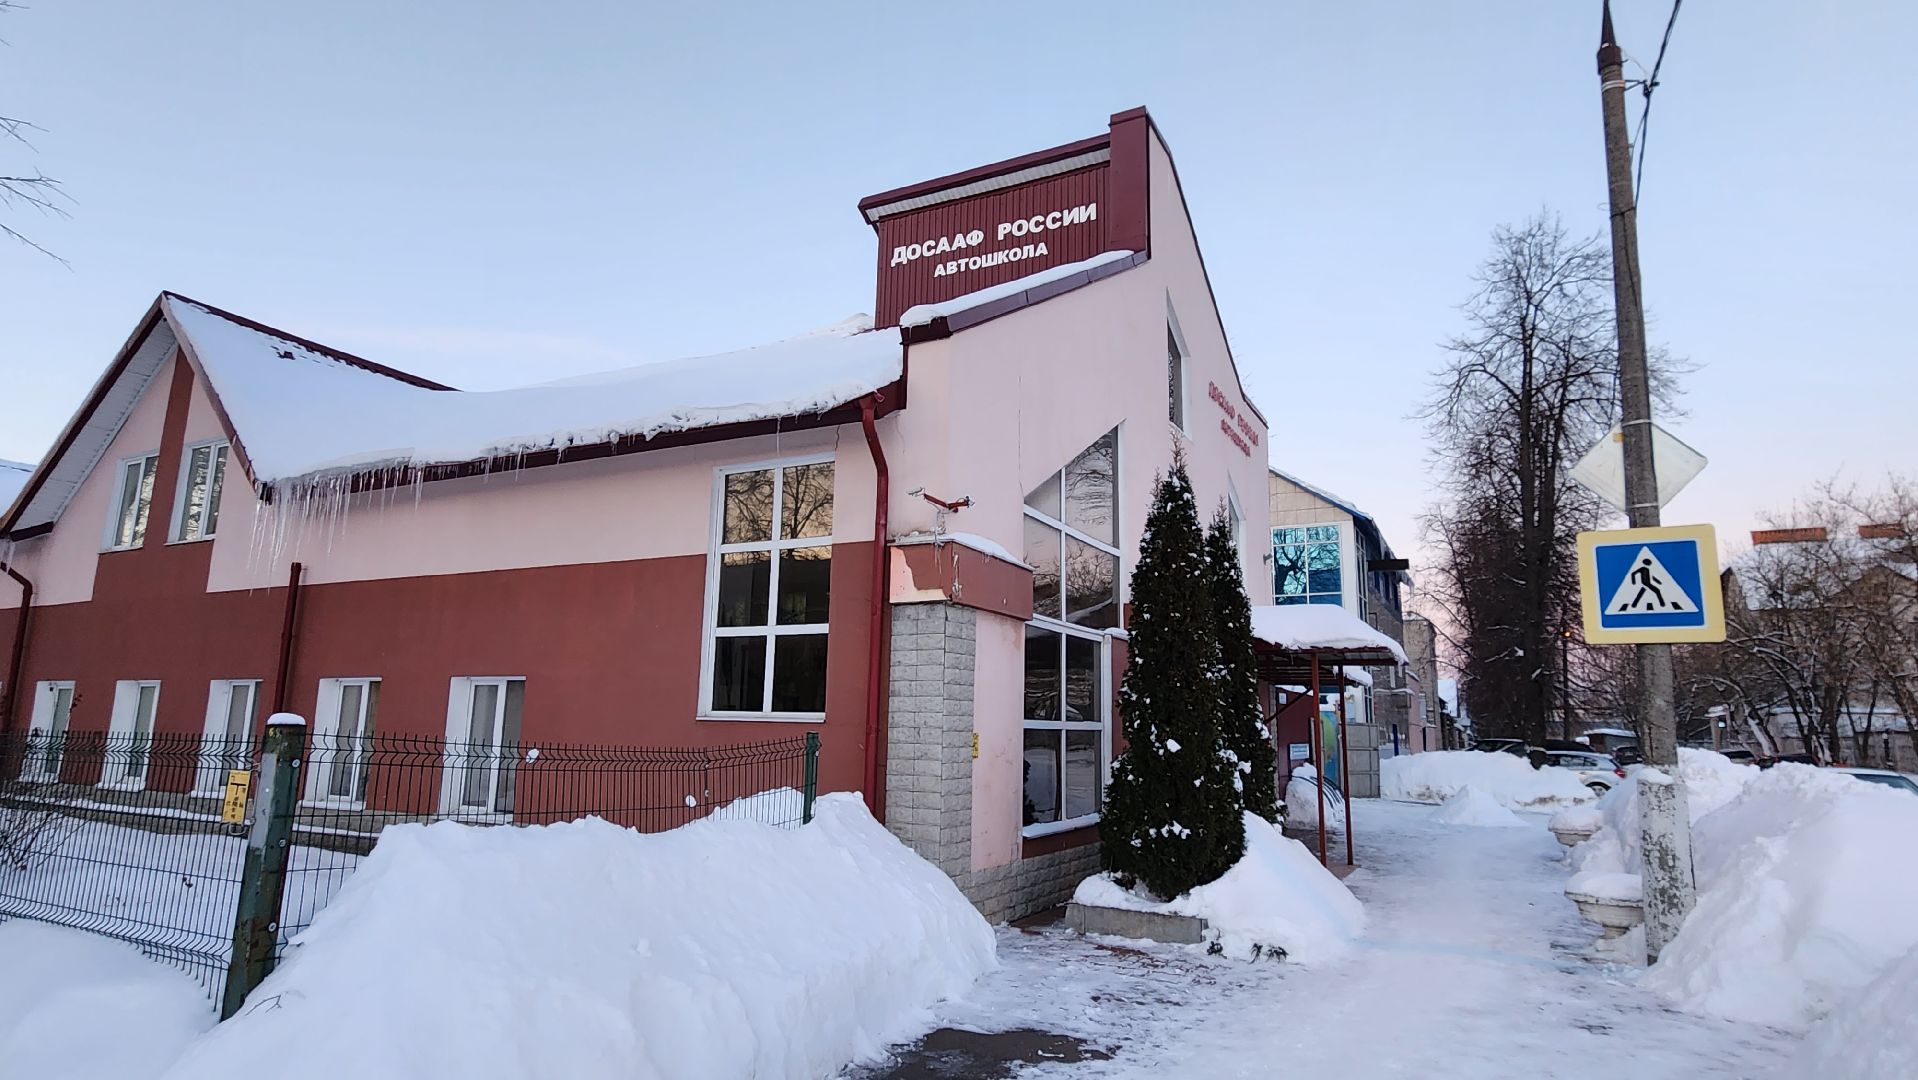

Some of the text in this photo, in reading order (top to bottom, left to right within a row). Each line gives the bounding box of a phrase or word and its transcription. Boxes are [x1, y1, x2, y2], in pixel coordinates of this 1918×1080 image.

[890, 202, 1098, 268] ДОСААФ РОССИИ
[933, 242, 1048, 279] АВТОШКОЛА
